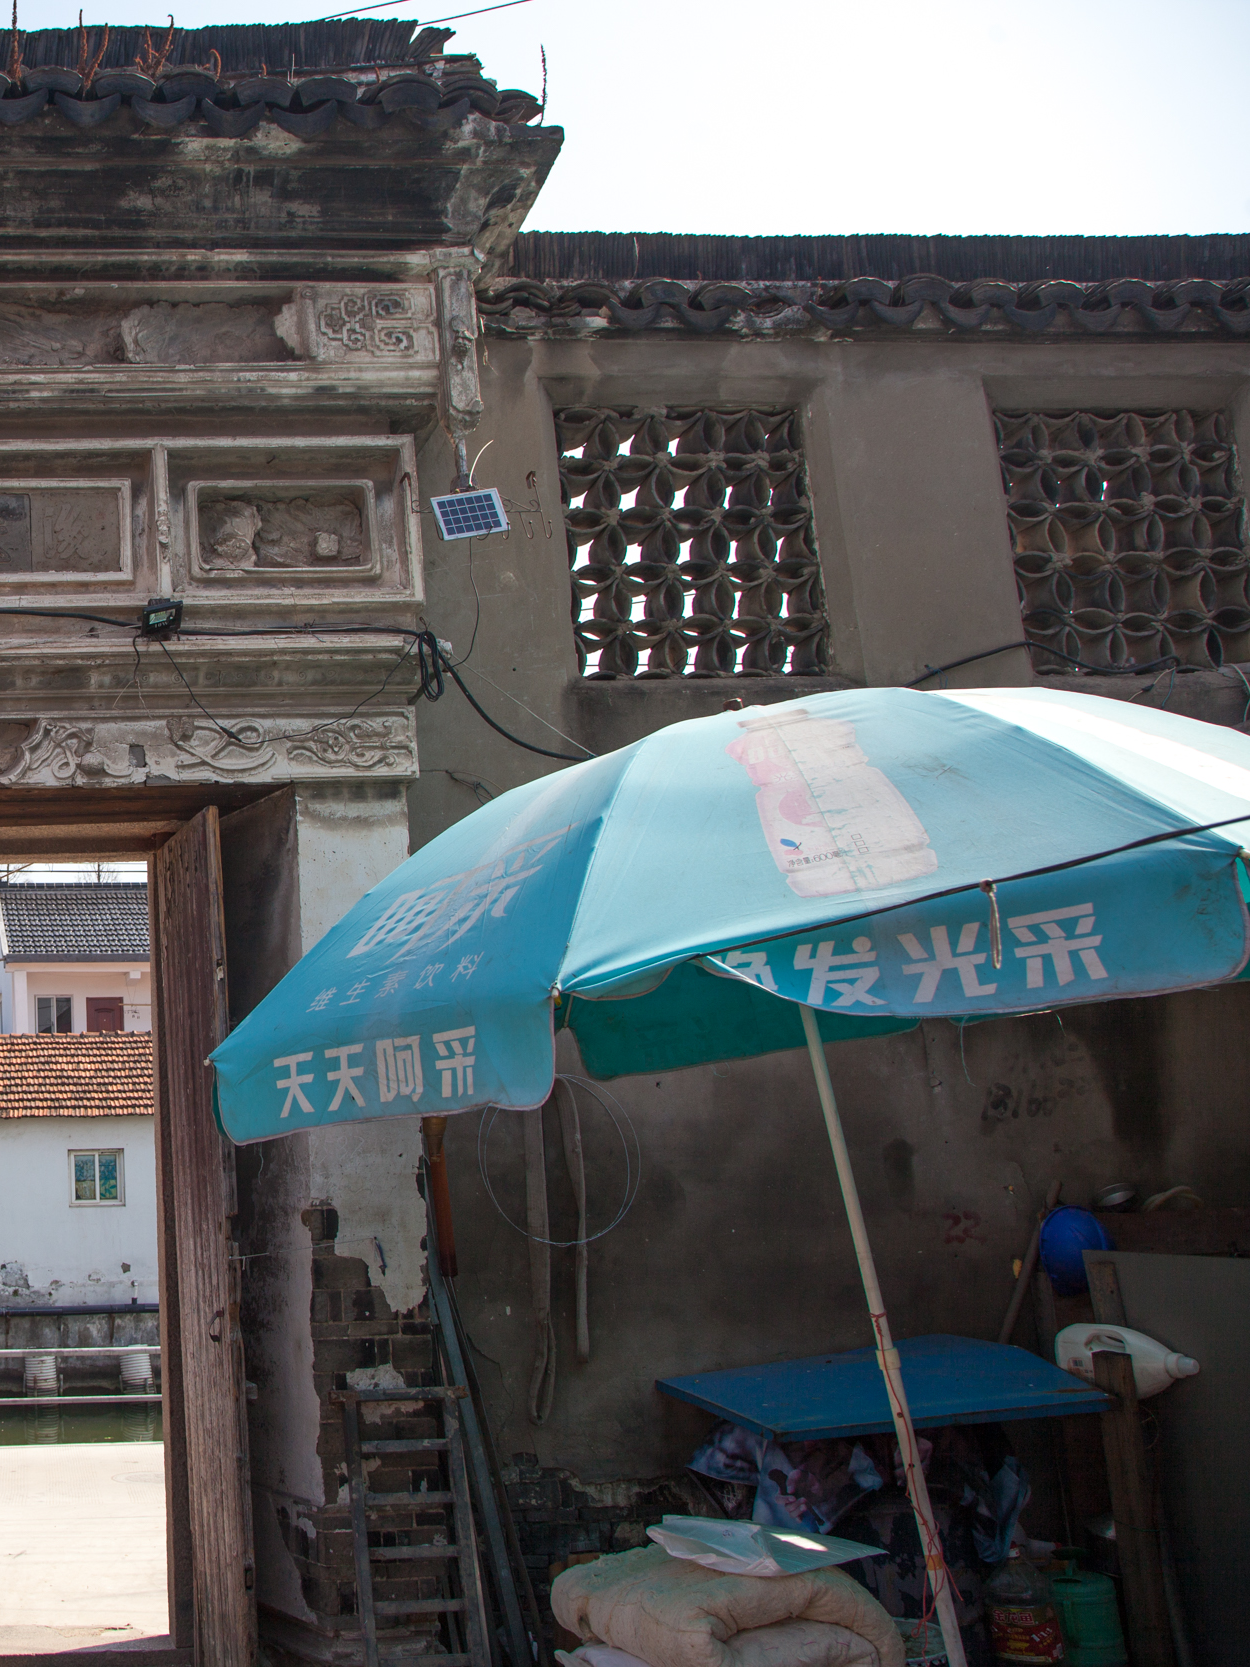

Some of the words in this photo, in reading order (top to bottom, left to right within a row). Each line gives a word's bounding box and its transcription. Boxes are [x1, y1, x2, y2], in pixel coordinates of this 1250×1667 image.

[305, 951, 485, 1013] 维生素饮料
[273, 1025, 477, 1118] 天天呵采
[992, 1608, 1035, 1626] 金龙鱼
